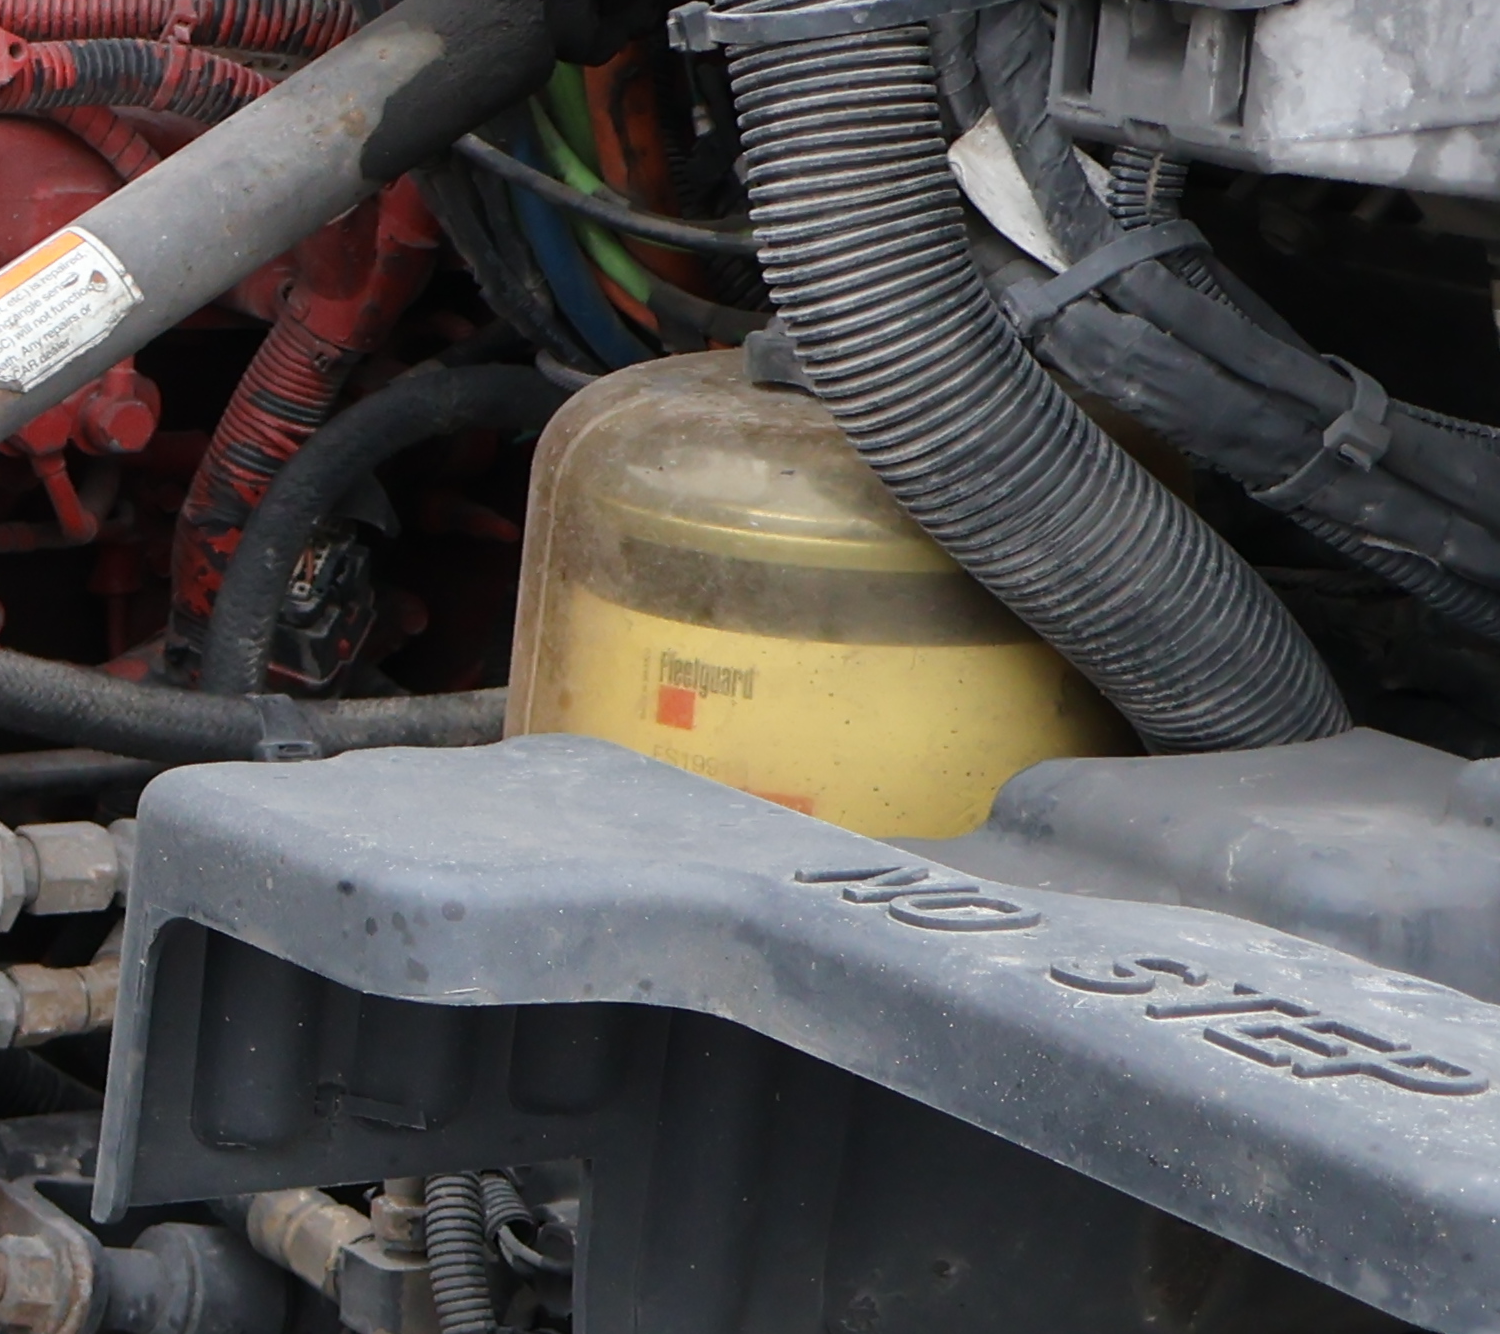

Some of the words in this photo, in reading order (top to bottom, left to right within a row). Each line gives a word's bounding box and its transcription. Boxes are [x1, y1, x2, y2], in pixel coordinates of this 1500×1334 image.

[11, 297, 43, 323] angle
[29, 279, 41, 292] is
[11, 321, 33, 341] will
[31, 309, 51, 327] not
[19, 336, 44, 358] Any
[41, 311, 81, 343] repairs
[79, 303, 93, 317] or
[660, 648, 754, 700] Fleetguard
[793, 865, 1043, 932] NO
[1049, 957, 1491, 1097] STEP
